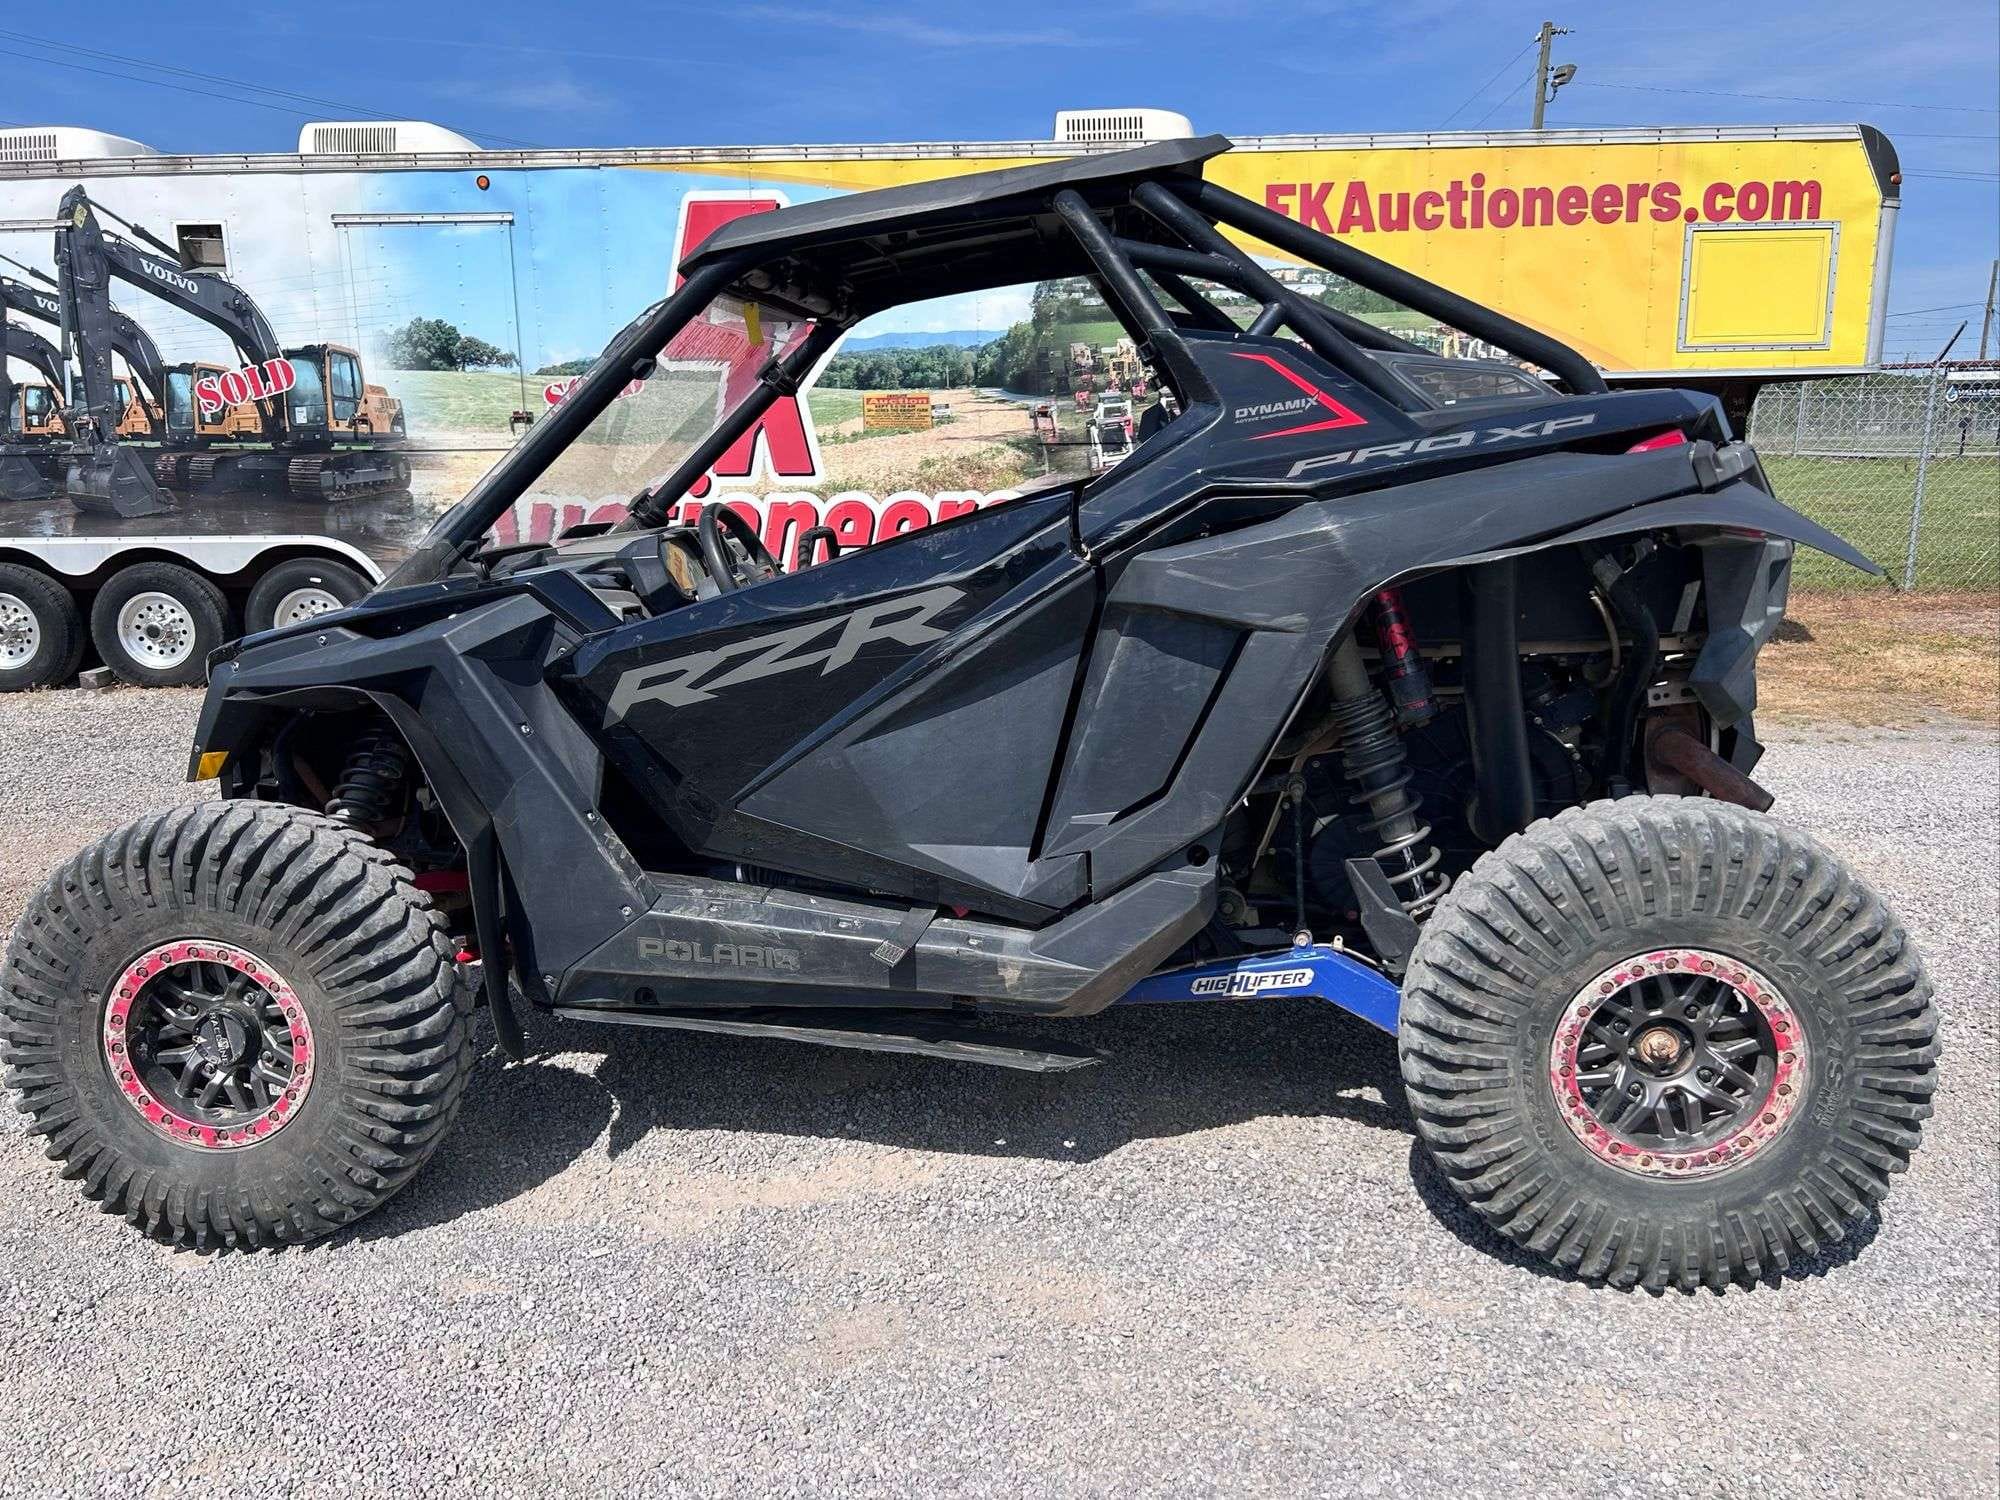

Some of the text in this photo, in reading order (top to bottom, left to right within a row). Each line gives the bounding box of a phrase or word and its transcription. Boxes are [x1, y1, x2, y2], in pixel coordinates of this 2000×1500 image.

[139, 257, 199, 294] VOLVO
[196, 358, 296, 414] SOLD
[1235, 391, 1320, 419] DYNAMIX
[1286, 414, 1597, 478] PRO XP
[602, 585, 968, 730] RZR
[637, 937, 801, 971] POLARIS
